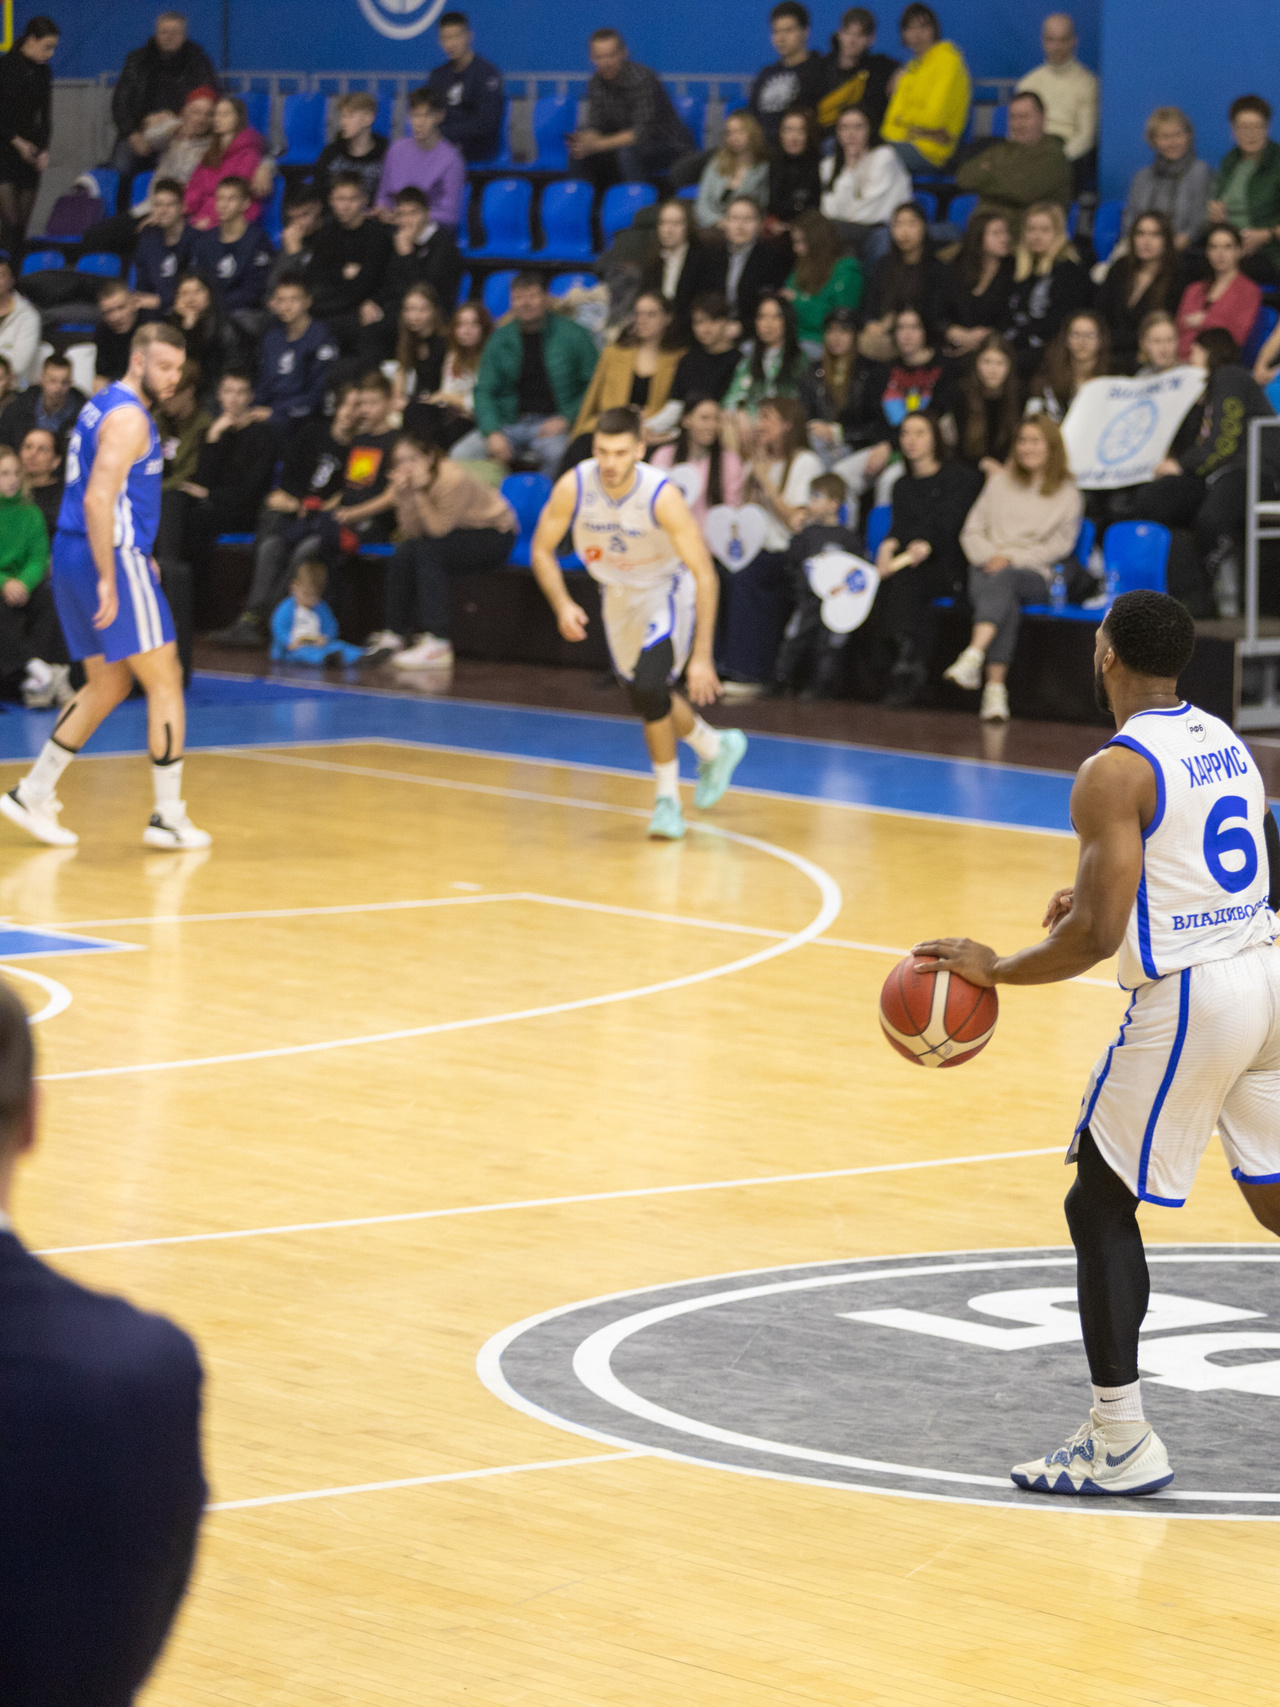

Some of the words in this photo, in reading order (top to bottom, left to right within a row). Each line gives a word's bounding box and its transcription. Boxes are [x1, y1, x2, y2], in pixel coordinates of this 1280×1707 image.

[1189, 724, 1204, 733] РФБ
[1180, 745, 1248, 789] ХАРРИС
[1203, 795, 1258, 893] 6
